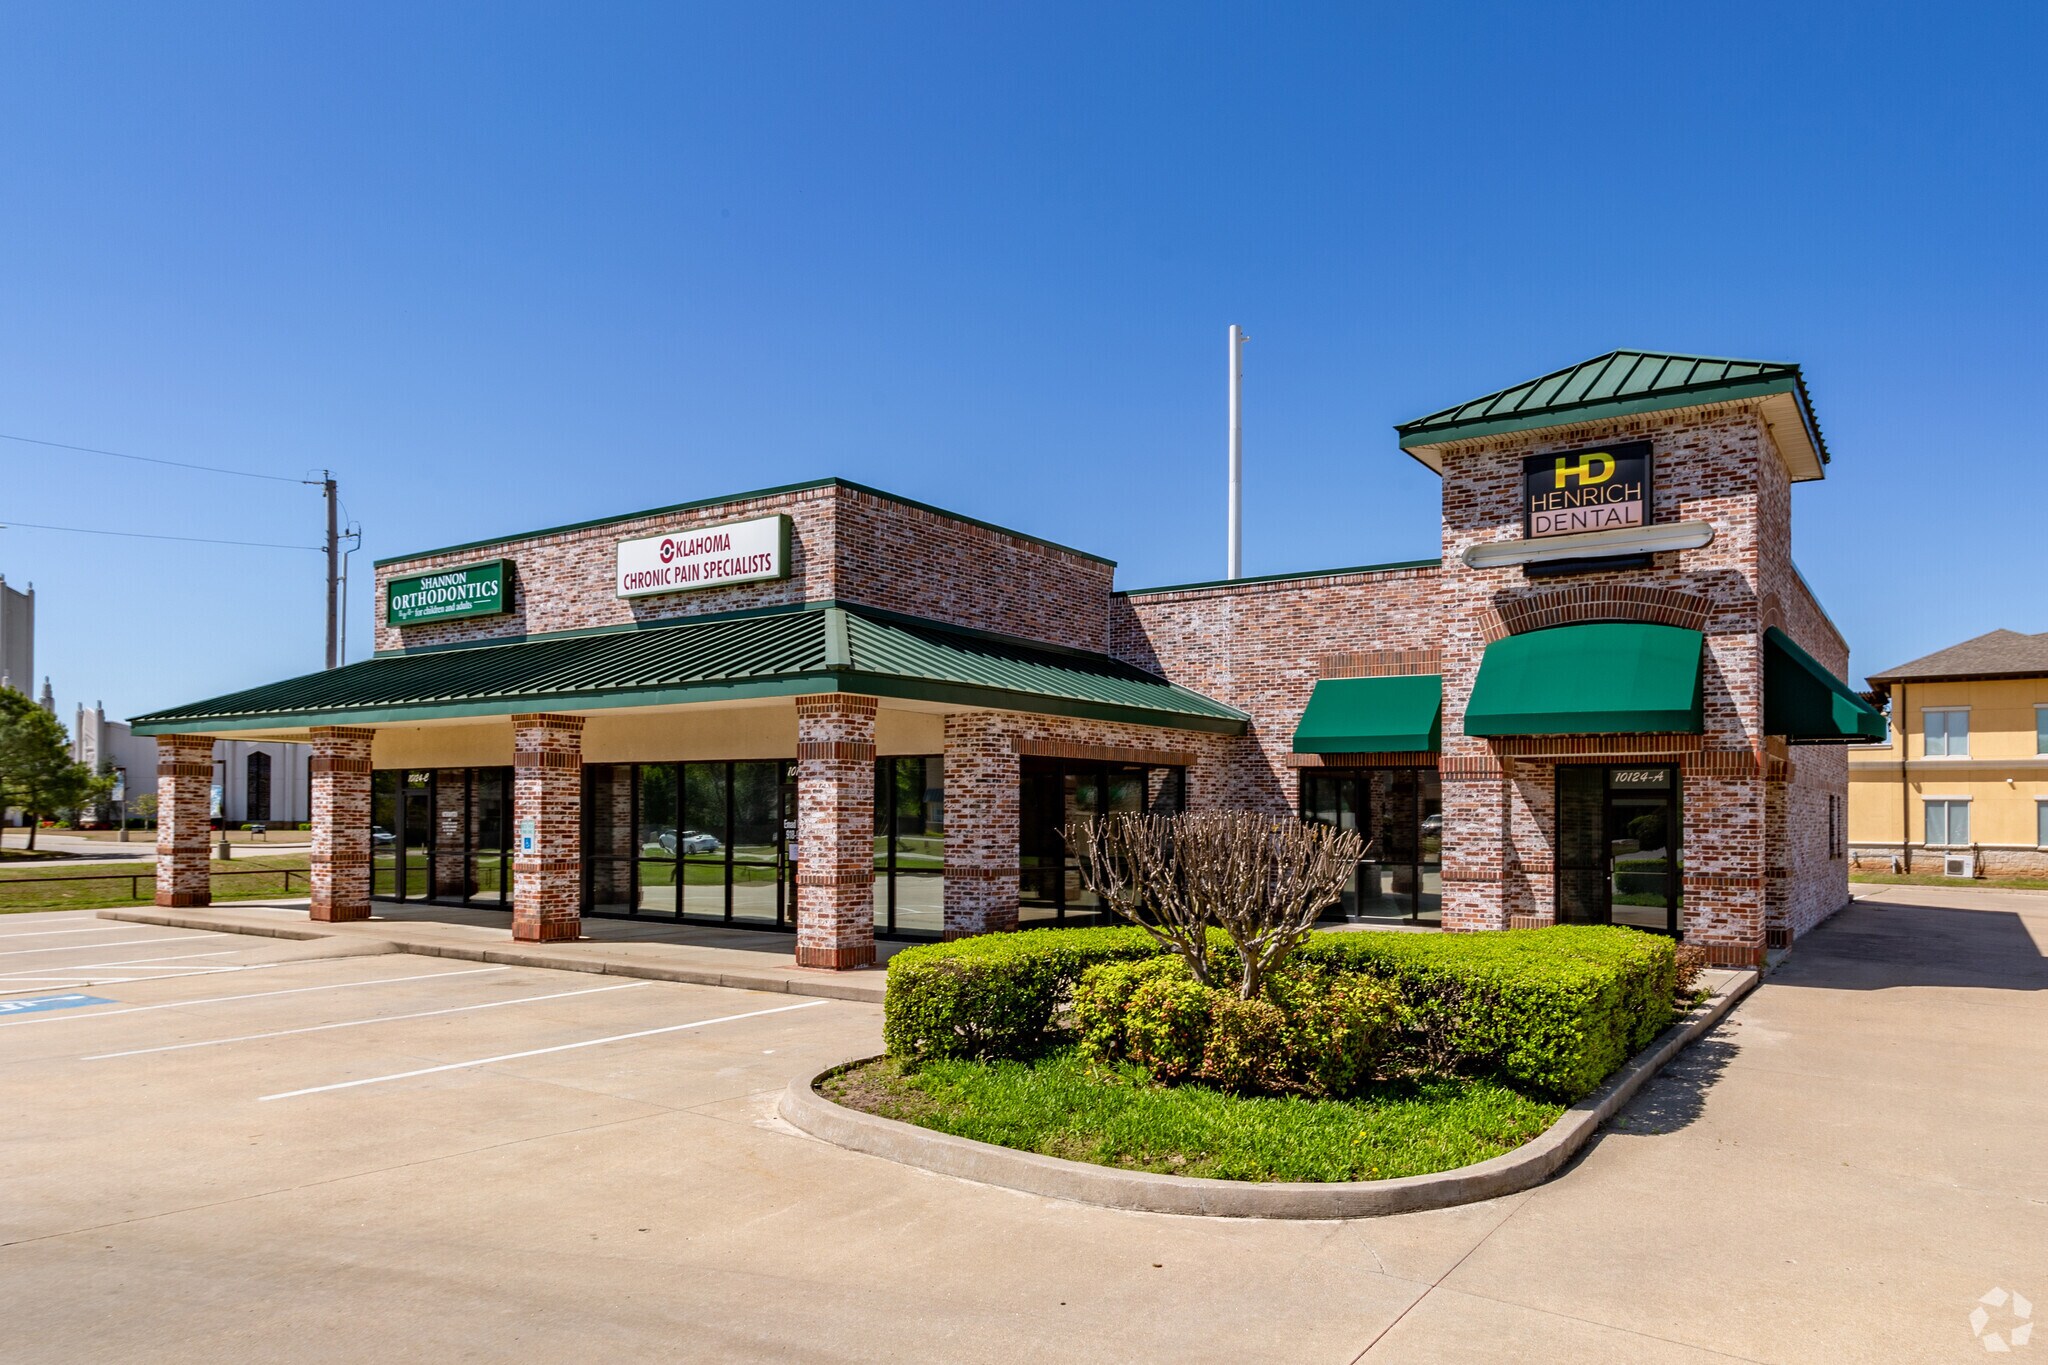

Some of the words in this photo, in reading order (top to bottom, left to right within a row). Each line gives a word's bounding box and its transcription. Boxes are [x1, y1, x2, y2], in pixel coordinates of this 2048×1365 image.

[1555, 452, 1615, 488] HD
[1531, 481, 1641, 512] HENRICH
[1536, 506, 1638, 533] DENTAL
[421, 572, 466, 590] SHANNON
[623, 567, 671, 590] CHRONIC
[674, 563, 700, 583] PAIN
[703, 552, 771, 580] SPECIALISTS
[392, 580, 498, 610] ORTHODONTICS
[415, 607, 423, 617] for
[423, 604, 445, 616] children
[445, 602, 456, 612] and
[456, 600, 473, 611] adults
[1615, 770, 1664, 782] 10124-A
